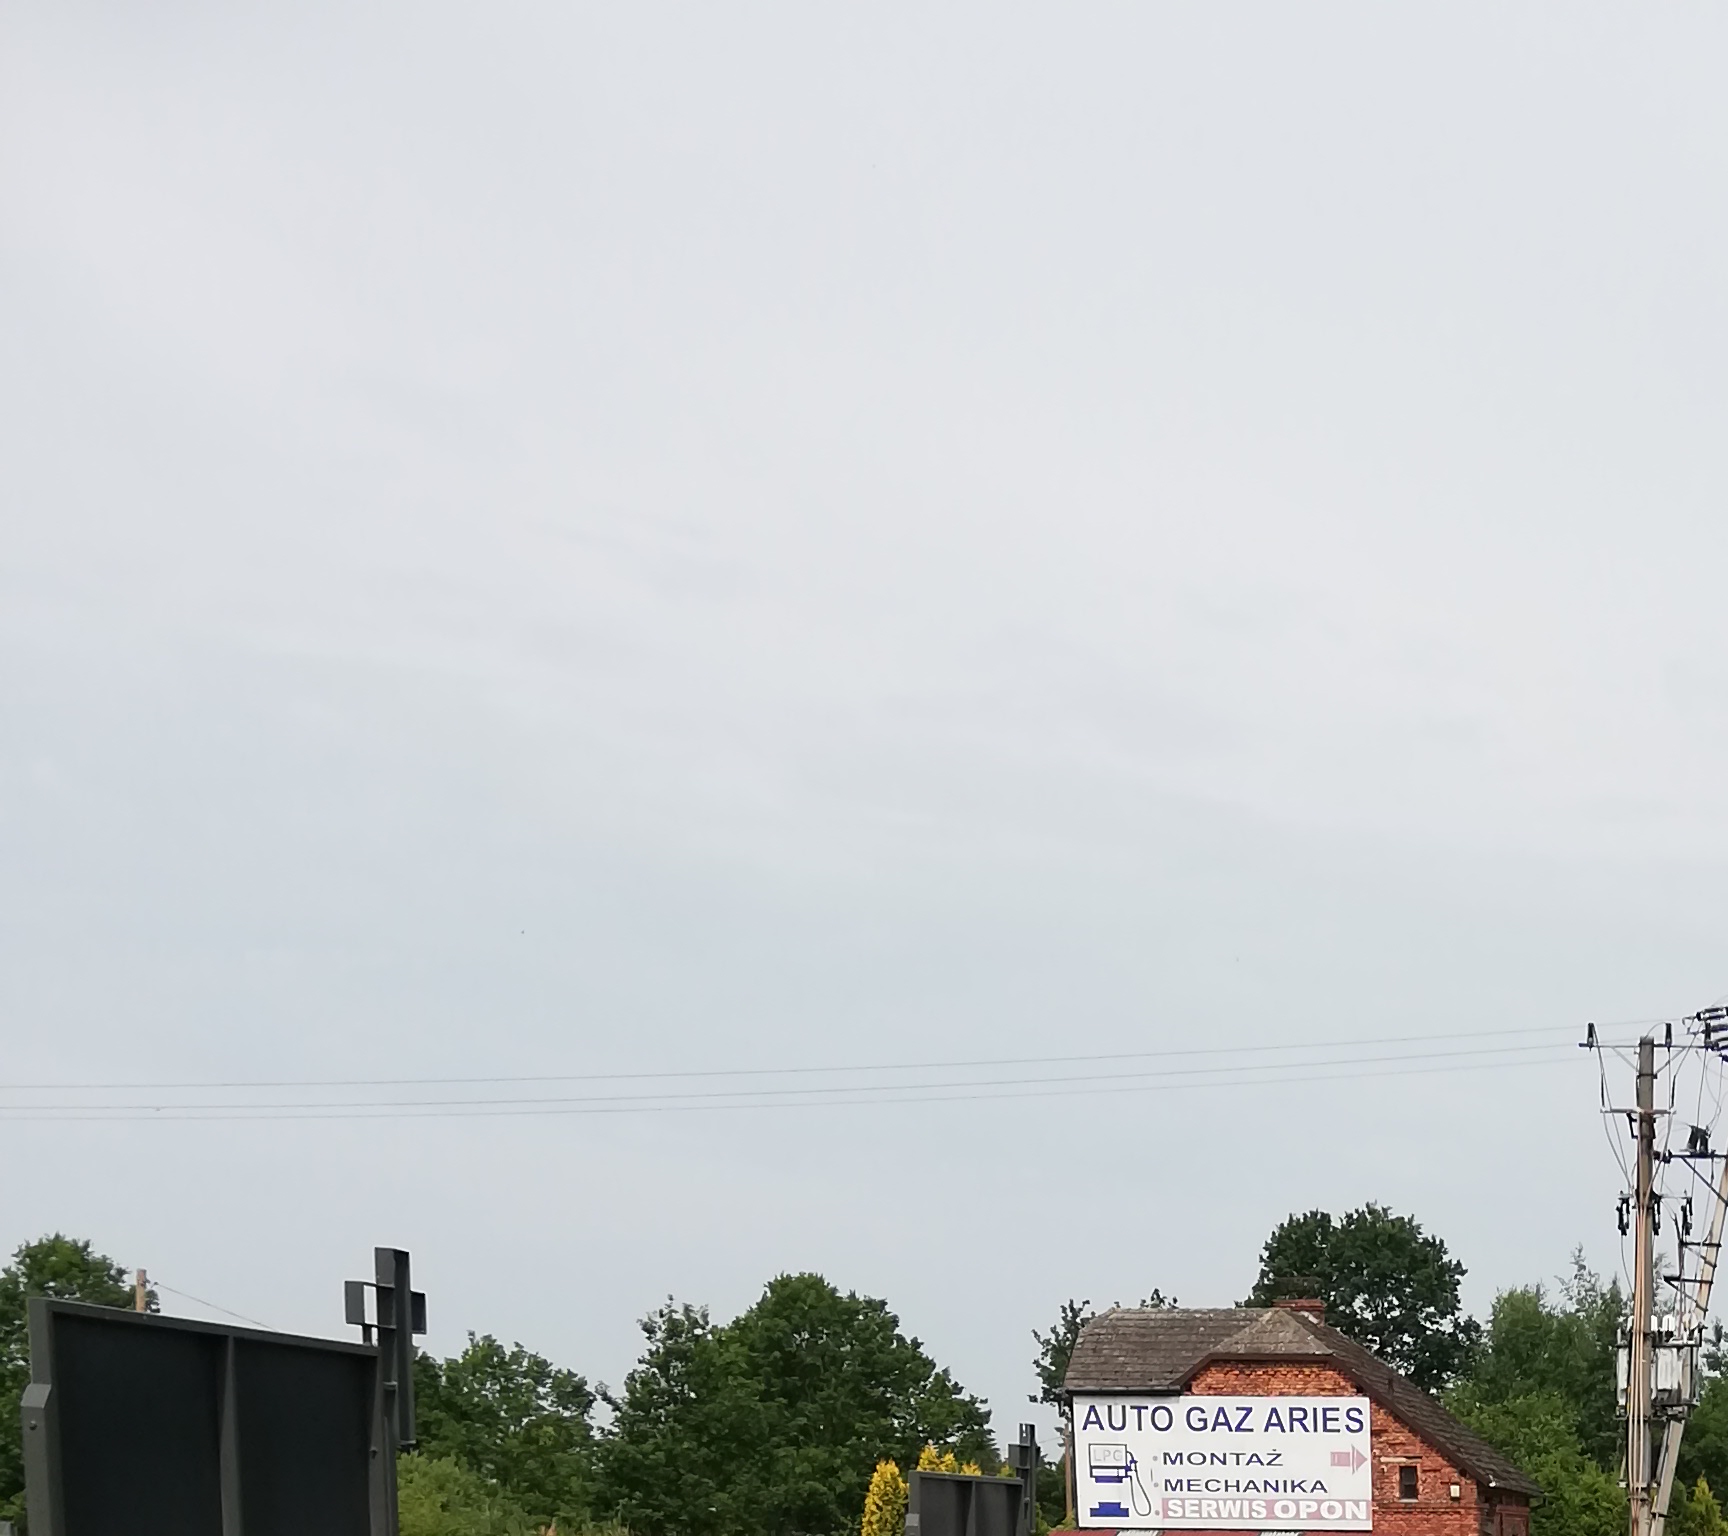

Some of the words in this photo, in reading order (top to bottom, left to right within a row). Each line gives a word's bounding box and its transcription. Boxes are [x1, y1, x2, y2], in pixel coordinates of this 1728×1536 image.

[1082, 1405, 1173, 1432] AUTO
[1186, 1406, 1254, 1433] GAZ
[1264, 1407, 1364, 1433] ARIES
[1093, 1448, 1122, 1461] LPG
[1162, 1448, 1283, 1466] MONTAŻ
[1163, 1479, 1328, 1493] MECHANIKA
[1167, 1499, 1266, 1519] SERWIS
[1273, 1500, 1368, 1520] OPON
